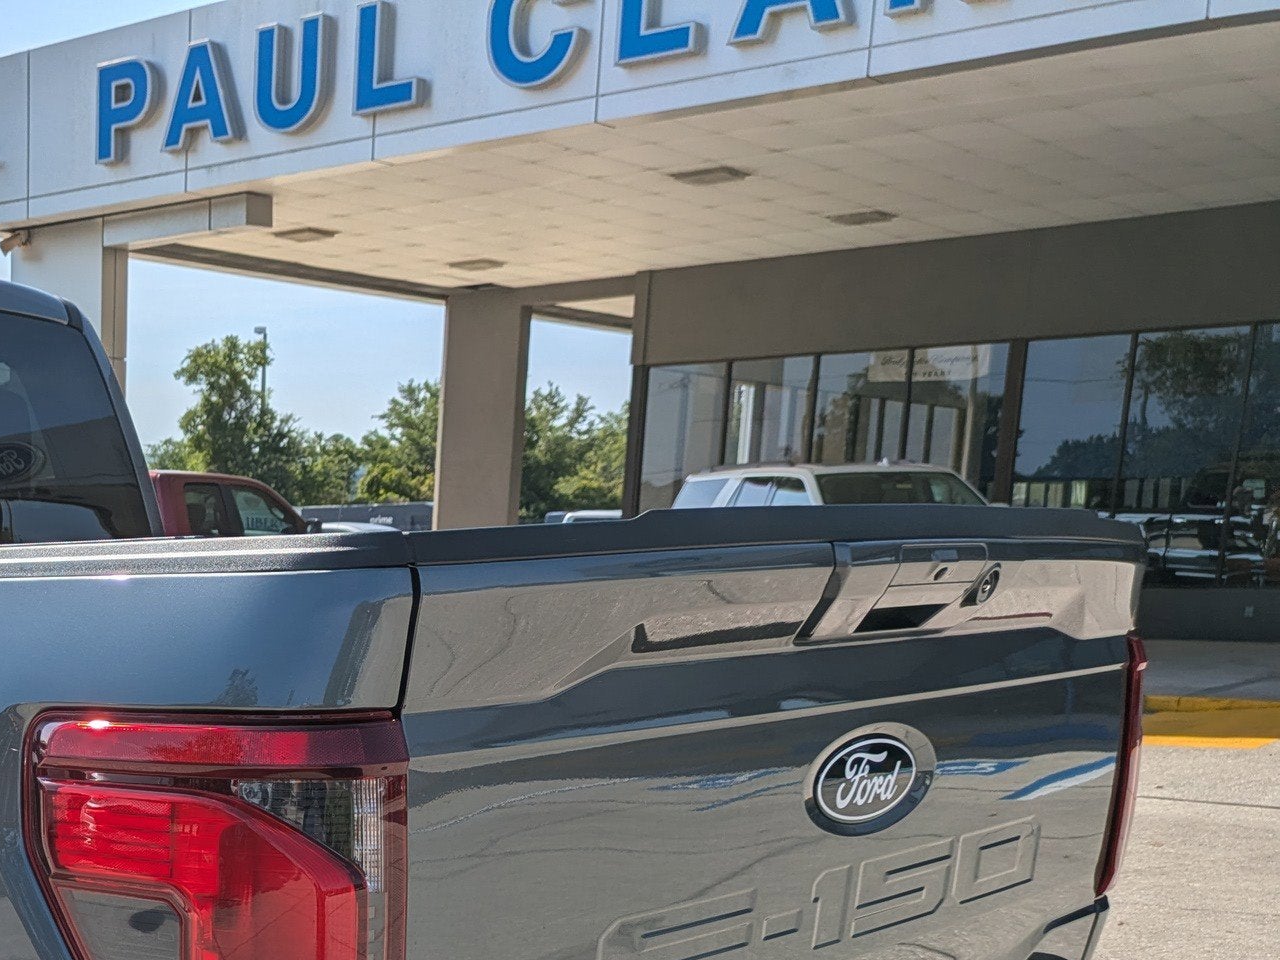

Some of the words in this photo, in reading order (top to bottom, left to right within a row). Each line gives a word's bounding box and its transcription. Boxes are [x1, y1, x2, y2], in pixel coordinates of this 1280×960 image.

[96, 0, 420, 164] PAUL
[487, 0, 916, 87] CL
[835, 750, 902, 810] Ford
